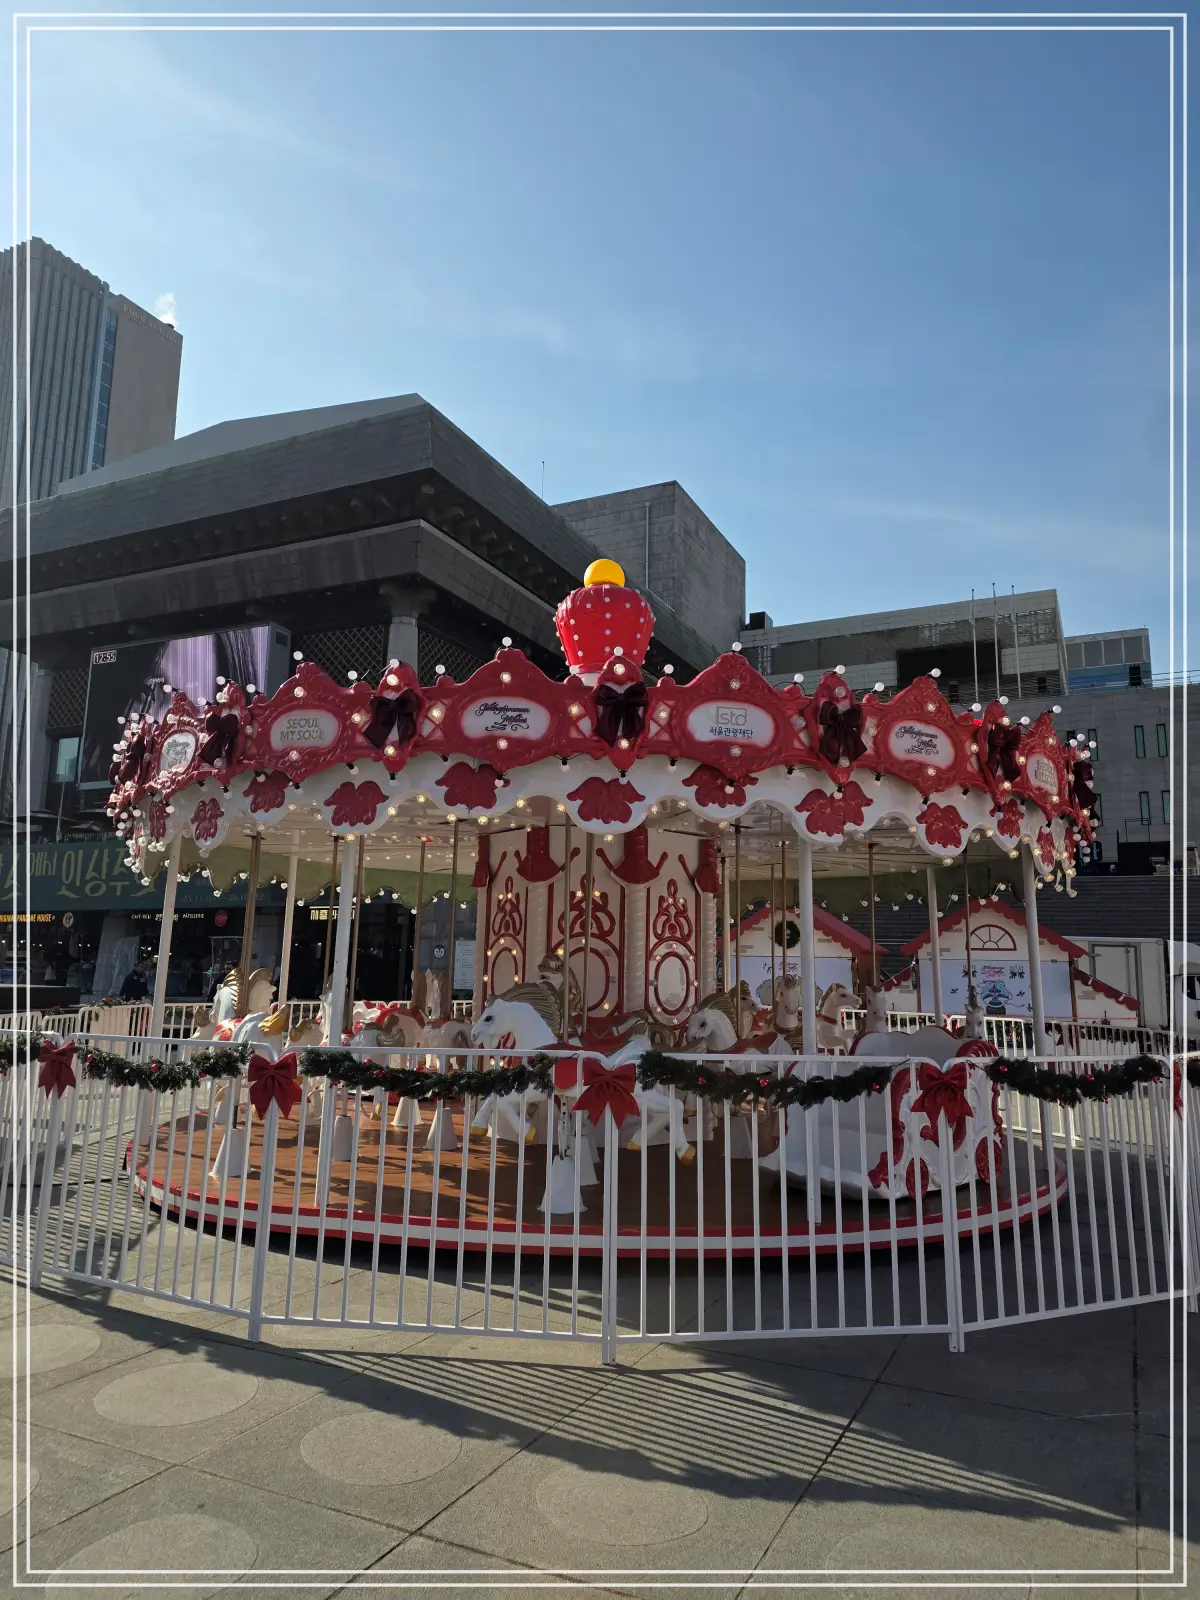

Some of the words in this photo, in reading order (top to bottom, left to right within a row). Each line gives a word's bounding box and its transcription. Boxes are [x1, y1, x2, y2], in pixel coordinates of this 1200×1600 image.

[95, 652, 116, 663] 12:55
[286, 717, 320, 729] SEOUL
[709, 726, 754, 738] 서울관광재단
